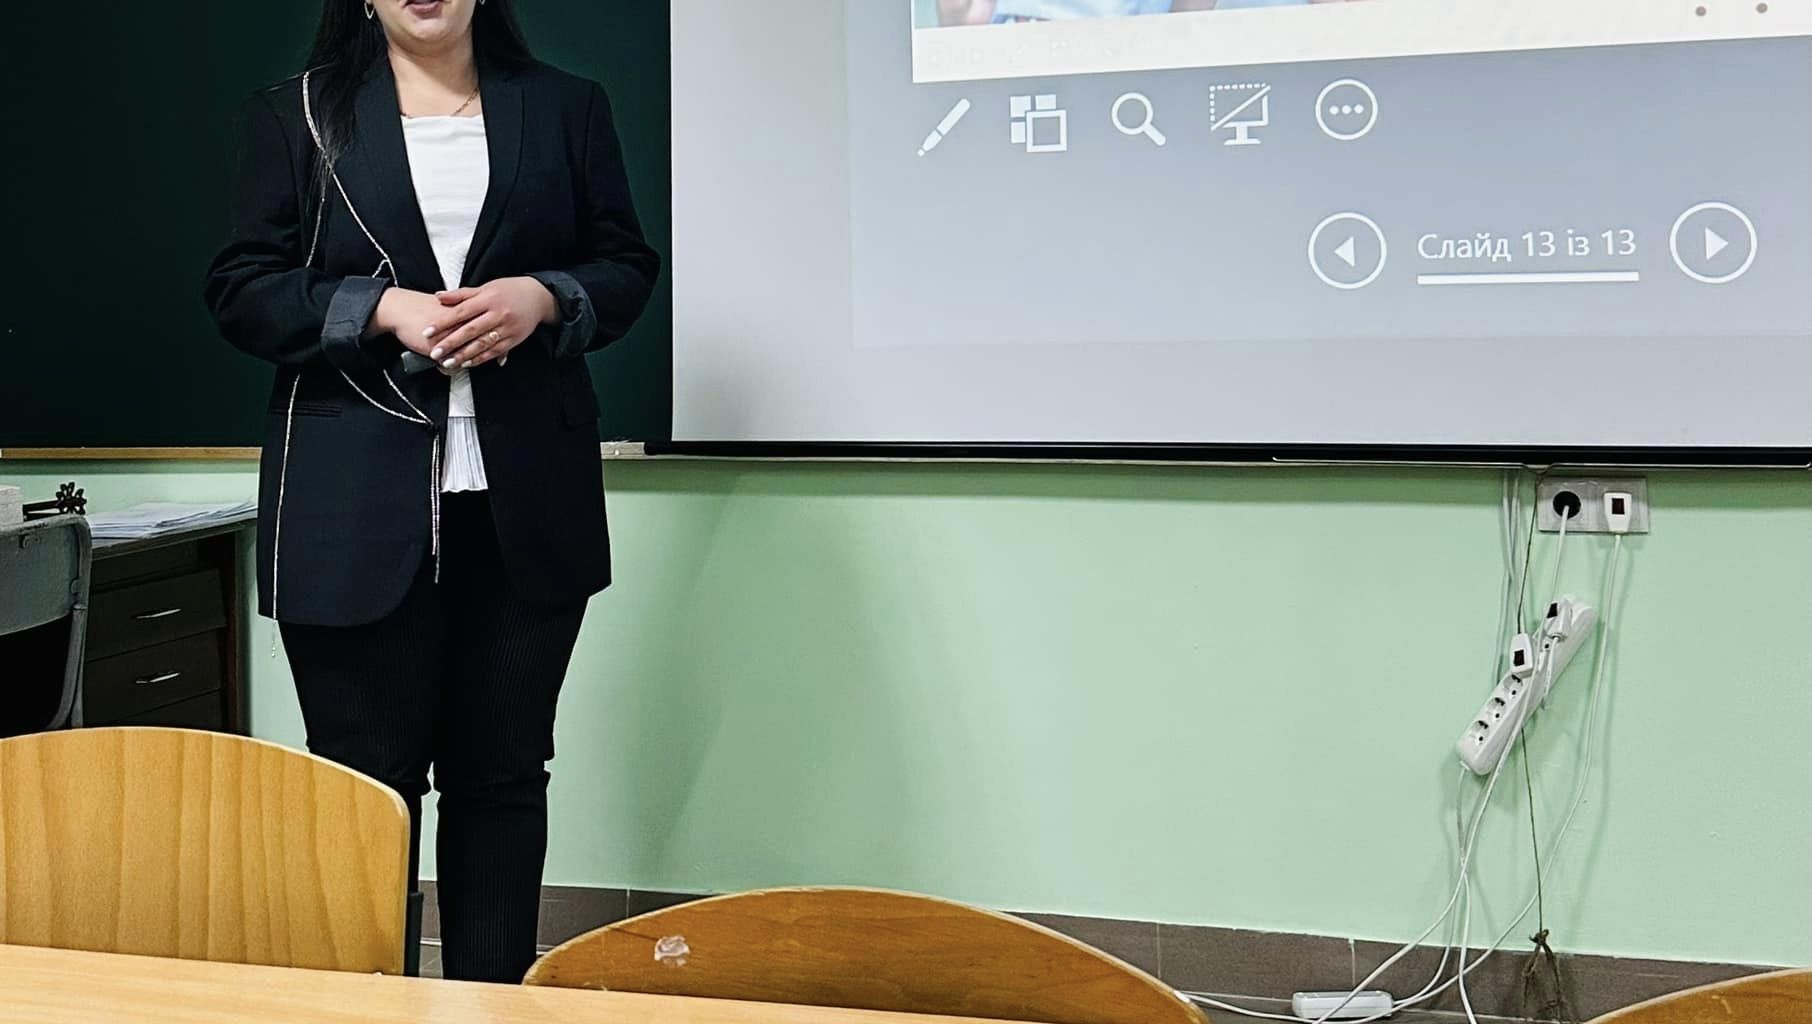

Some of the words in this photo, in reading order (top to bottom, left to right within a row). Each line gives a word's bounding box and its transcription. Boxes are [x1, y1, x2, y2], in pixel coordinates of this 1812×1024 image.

[1417, 232, 1512, 263] Слайд
[1522, 231, 1556, 258] 13
[1567, 228, 1591, 257] із
[1602, 229, 1637, 256] 13
